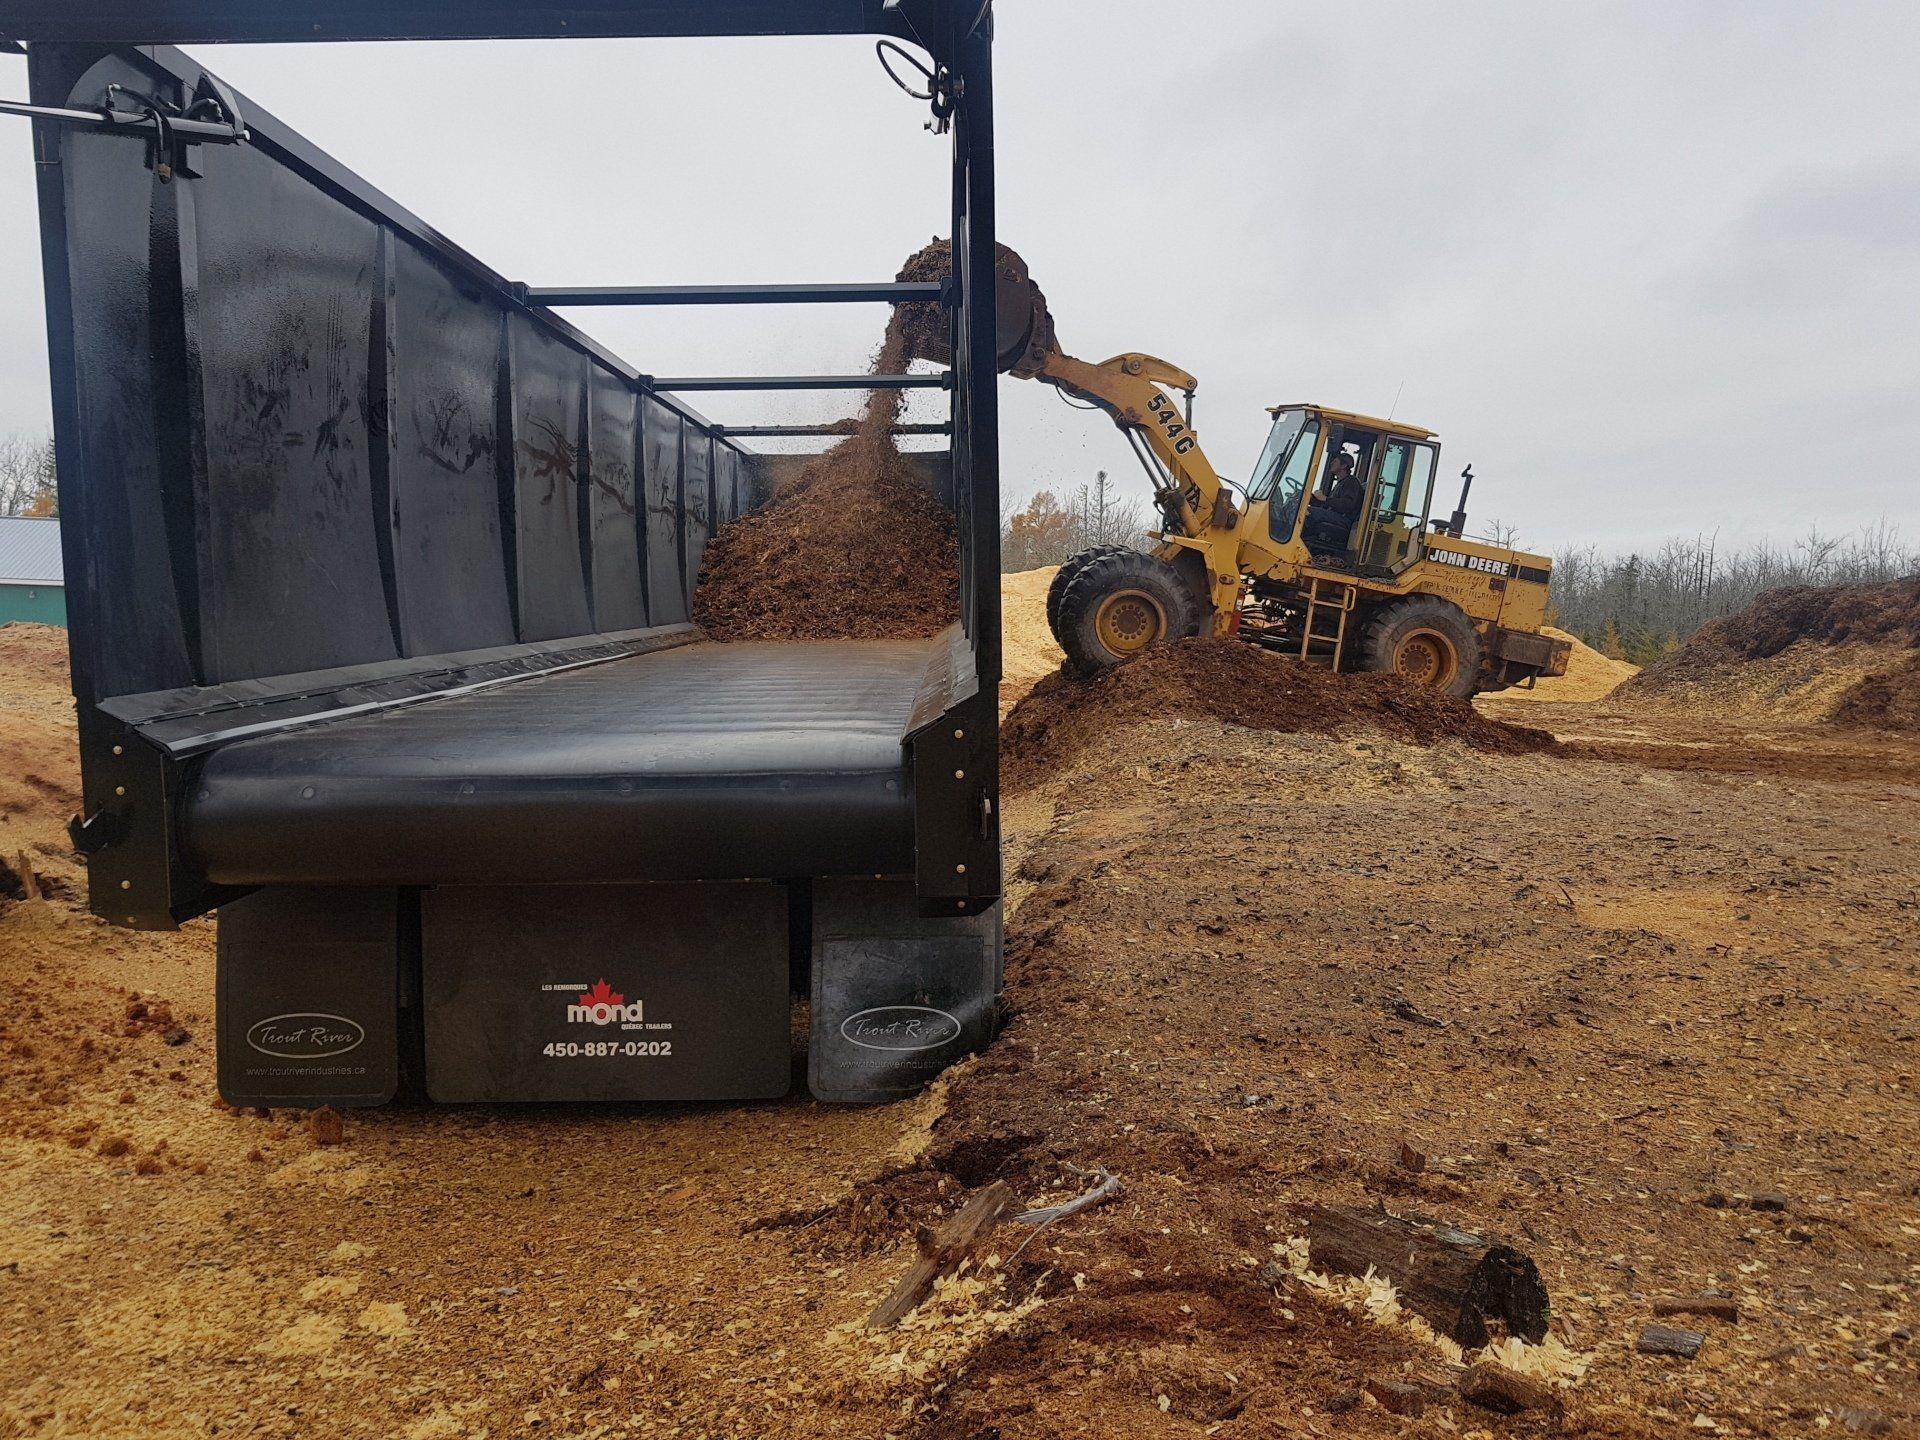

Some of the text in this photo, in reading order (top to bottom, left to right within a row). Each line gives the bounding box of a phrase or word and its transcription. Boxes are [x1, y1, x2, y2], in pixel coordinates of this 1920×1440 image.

[1147, 393, 1195, 455] 544G
[1430, 549, 1510, 576] JOHN DEERE
[553, 983, 588, 991] REMORQUES
[645, 1022, 672, 1030] TRAILERS
[855, 1018, 950, 1039] Trout River
[260, 1026, 353, 1046] Trout River
[543, 1041, 672, 1057] 450-887-0202
[246, 1066, 366, 1076] www.troutriverindustries.ca
